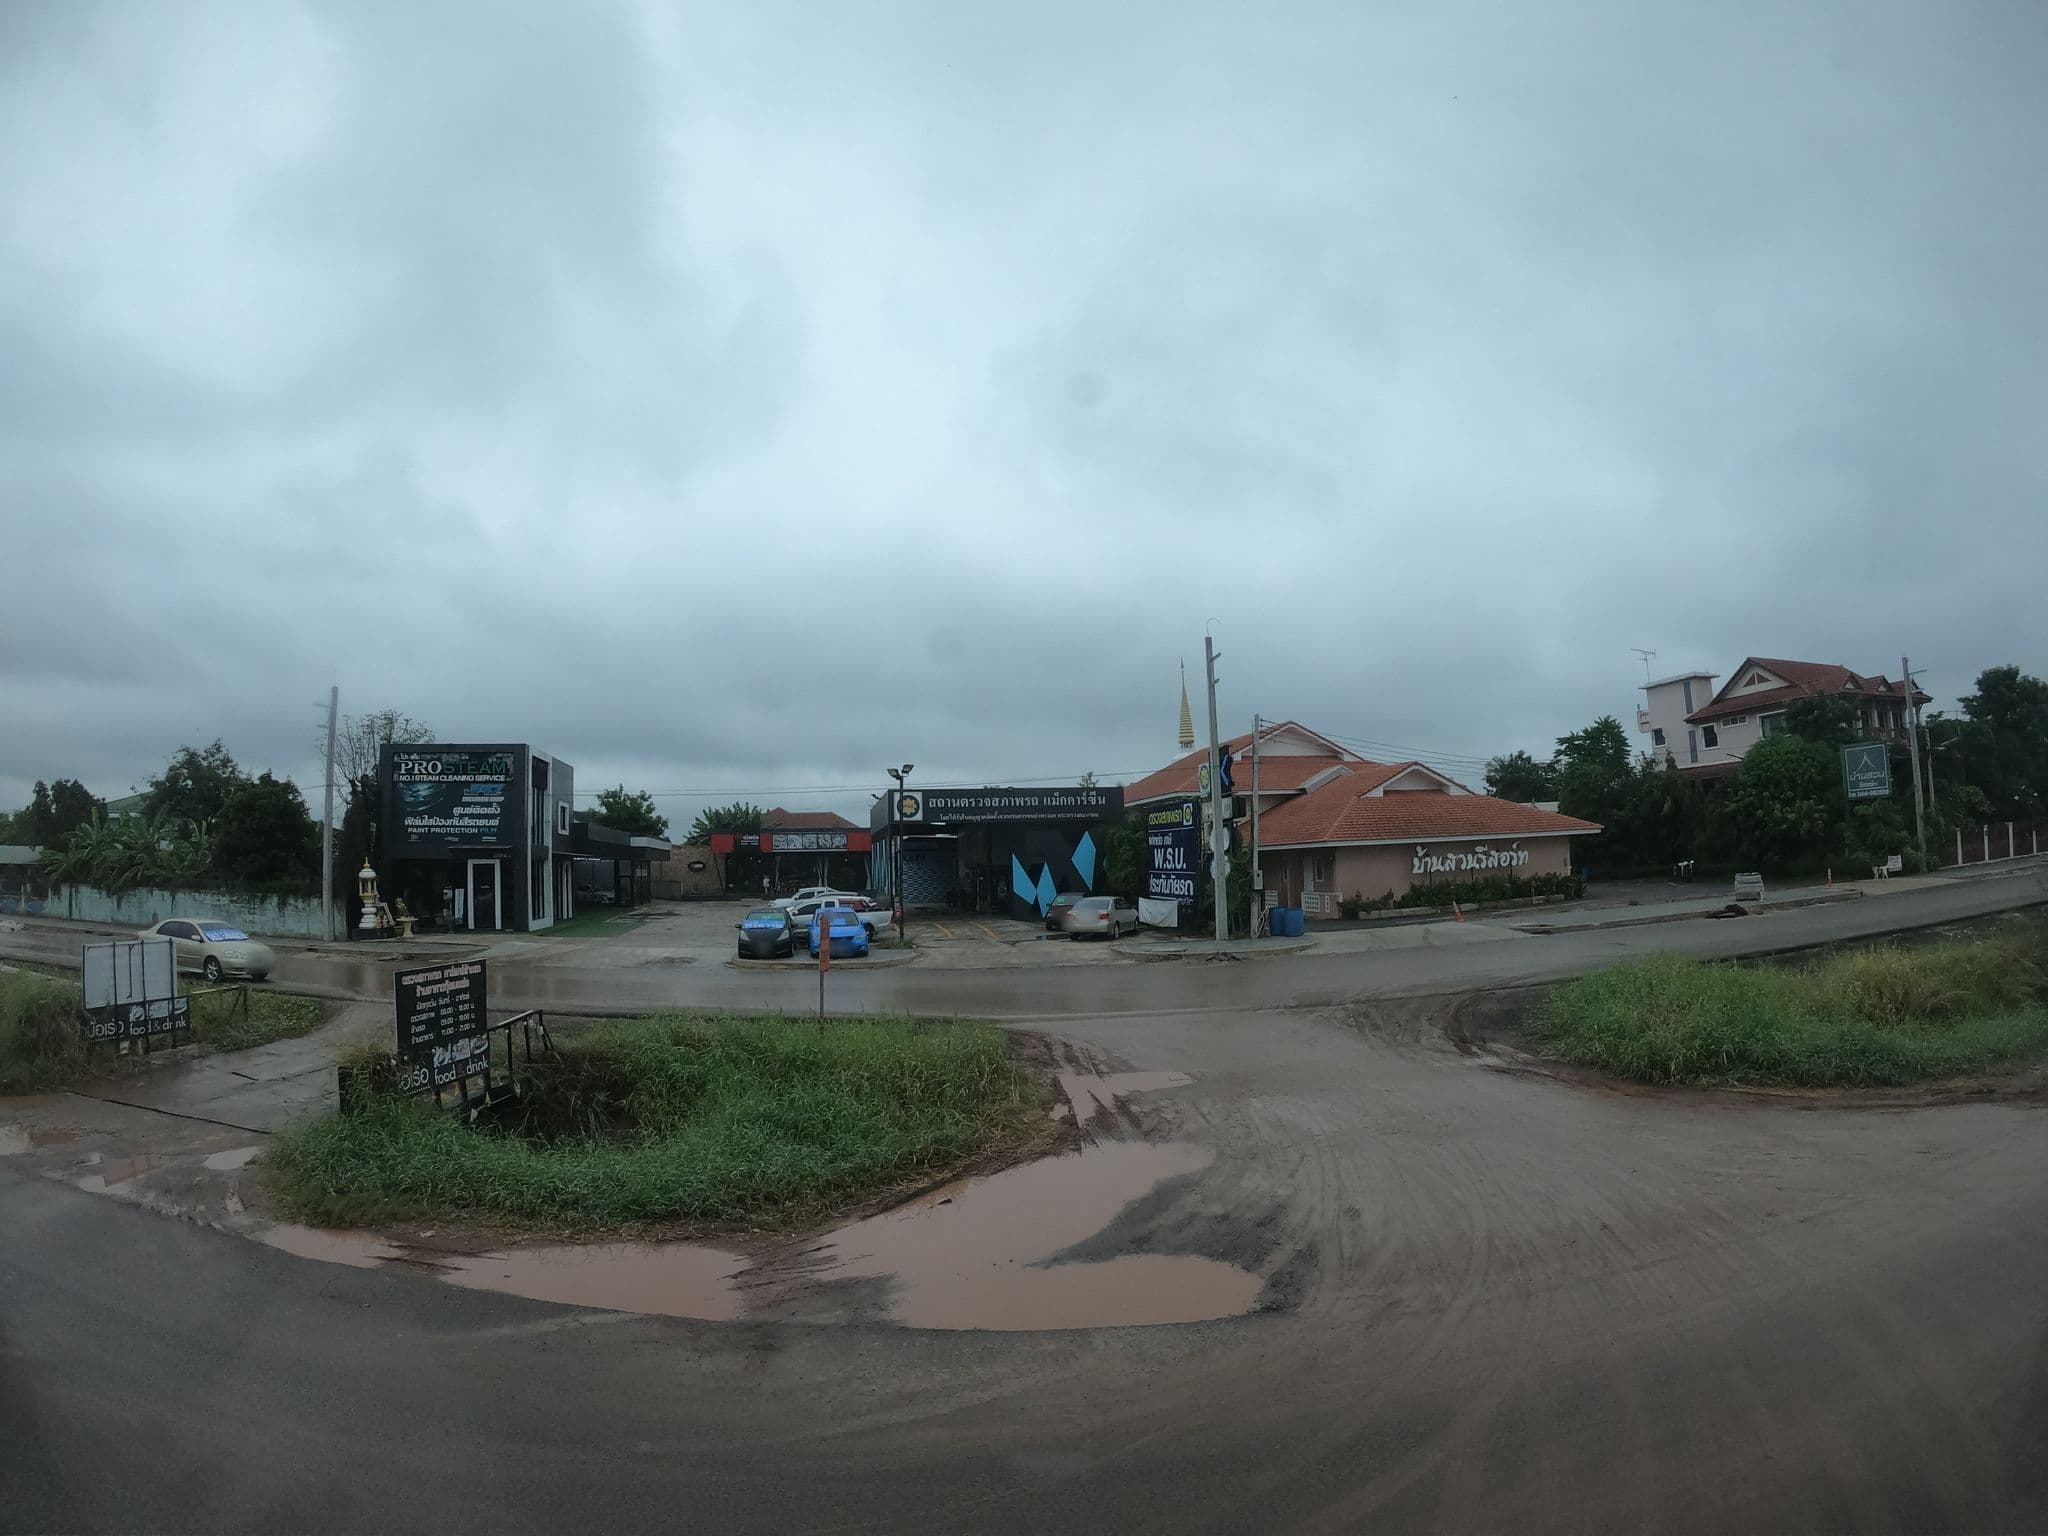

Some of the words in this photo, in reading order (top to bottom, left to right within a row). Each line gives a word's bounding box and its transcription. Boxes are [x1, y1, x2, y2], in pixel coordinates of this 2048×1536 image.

[399, 760, 442, 774] PRO
[1412, 841, 1529, 874] บ้านสวนรีสอร์ท
[162, 1016, 187, 1031] drnk
[434, 1064, 456, 1086] food
[466, 1055, 489, 1075] drink
